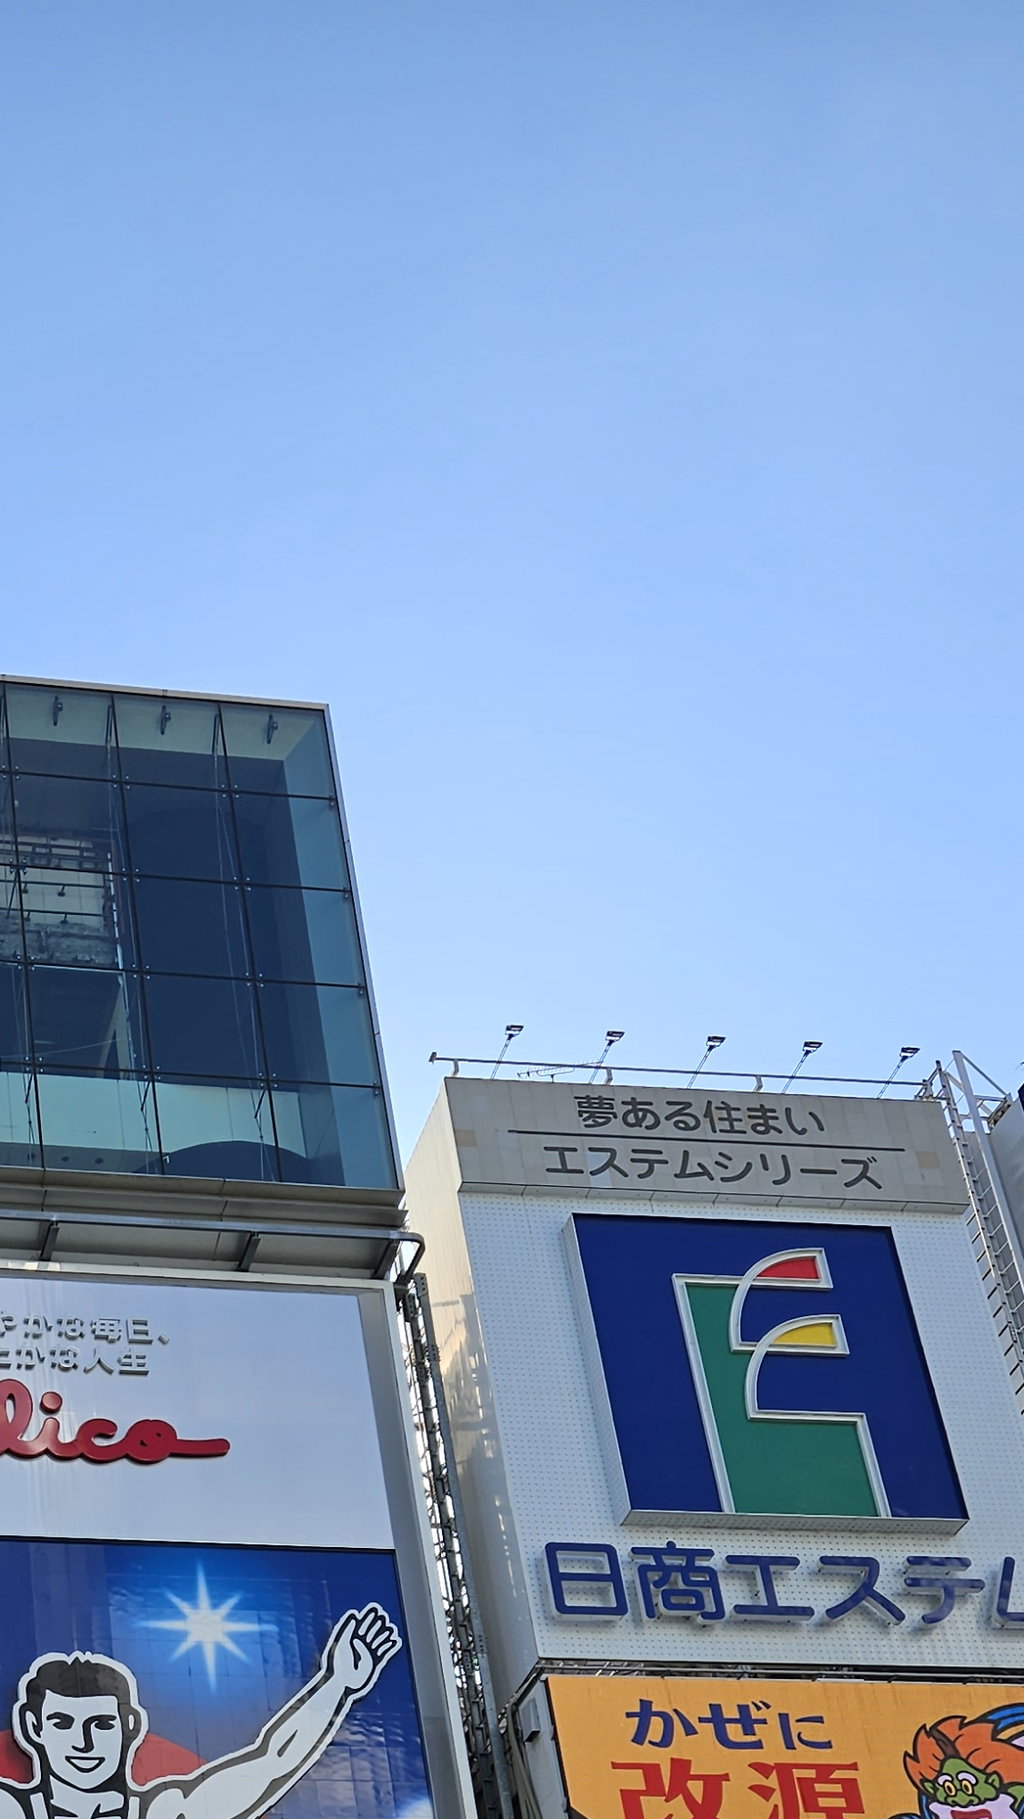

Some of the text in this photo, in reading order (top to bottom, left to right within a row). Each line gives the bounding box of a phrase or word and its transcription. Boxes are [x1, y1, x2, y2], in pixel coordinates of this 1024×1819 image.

[573, 1094, 826, 1137] 夢ある住まい
[543, 1145, 883, 1190] エステムシリーズ
[626, 1698, 834, 1751] かぜに
